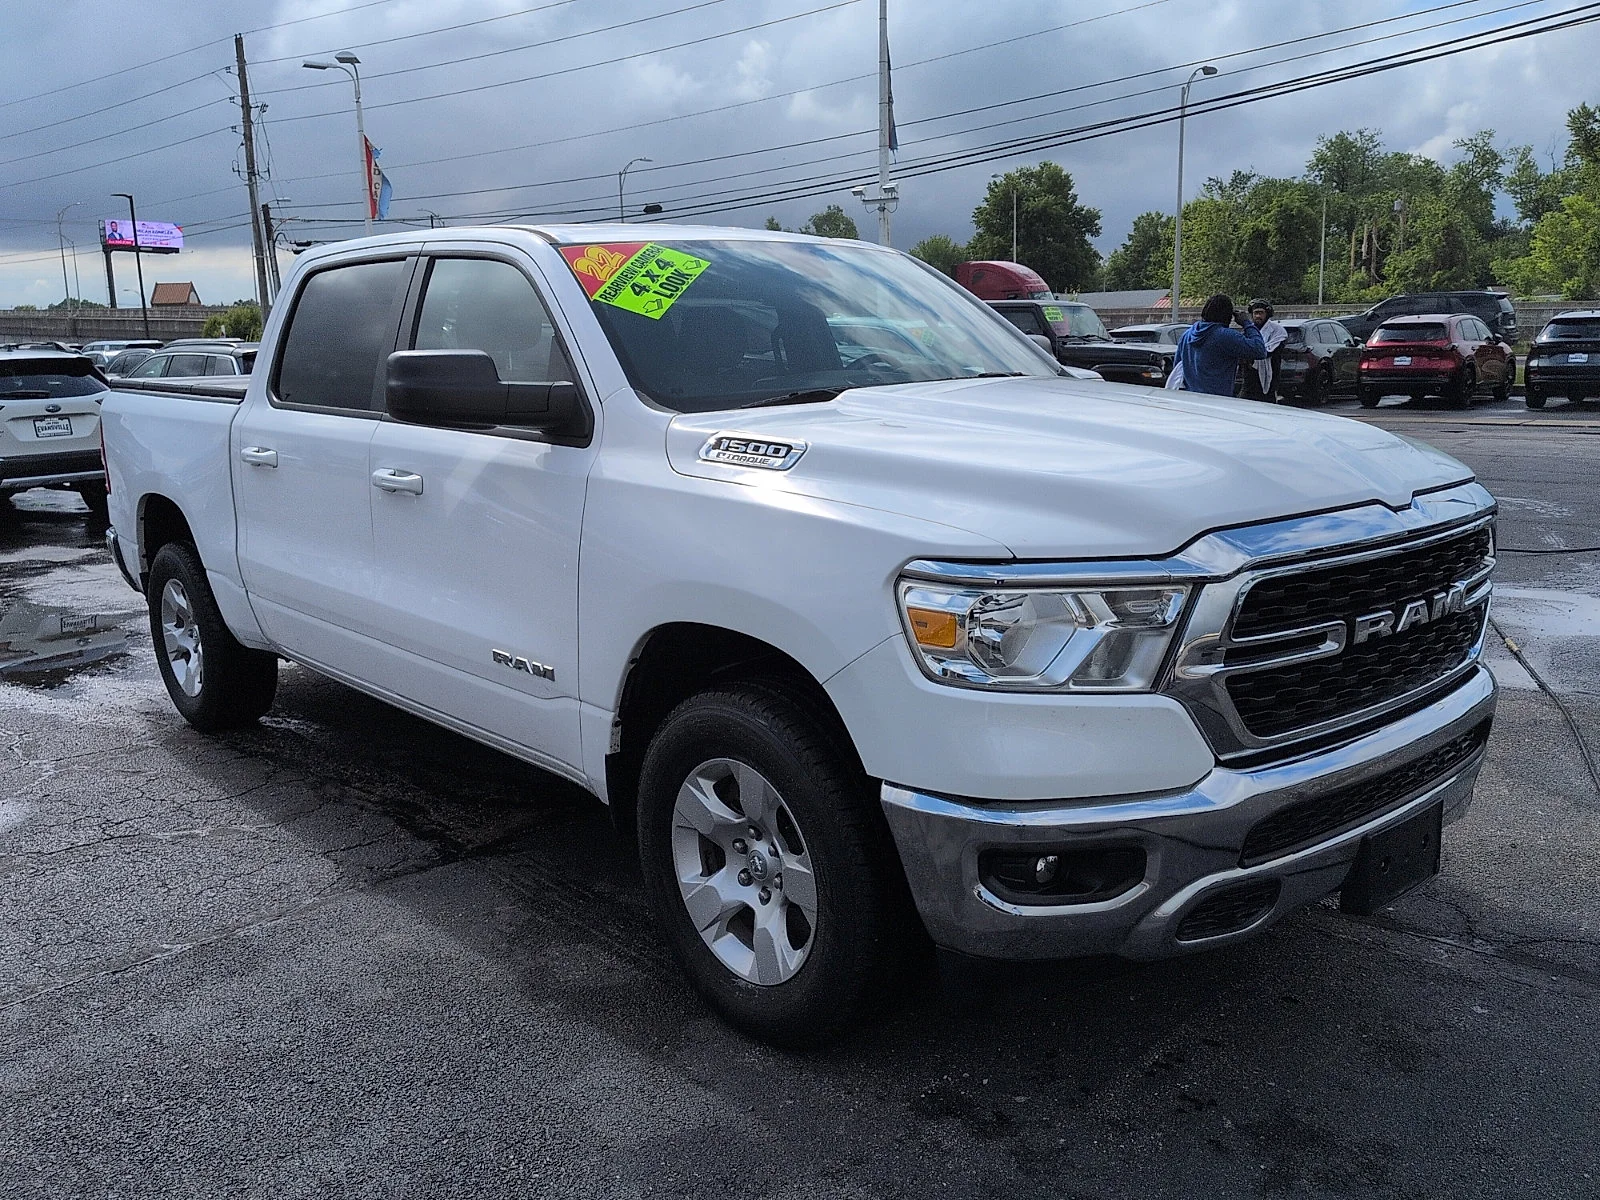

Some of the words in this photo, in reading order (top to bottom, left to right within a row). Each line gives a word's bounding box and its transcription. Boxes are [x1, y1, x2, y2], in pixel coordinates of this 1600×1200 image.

[573, 246, 626, 281] 22
[599, 265, 642, 302] REARVIEW
[635, 244, 666, 270] CAMERA
[629, 282, 652, 298] 4
[654, 257, 677, 272] 4
[652, 268, 695, 299] LOOK
[720, 439, 787, 457] 1500
[1353, 586, 1465, 645] RAM
[492, 648, 556, 682] RAM
